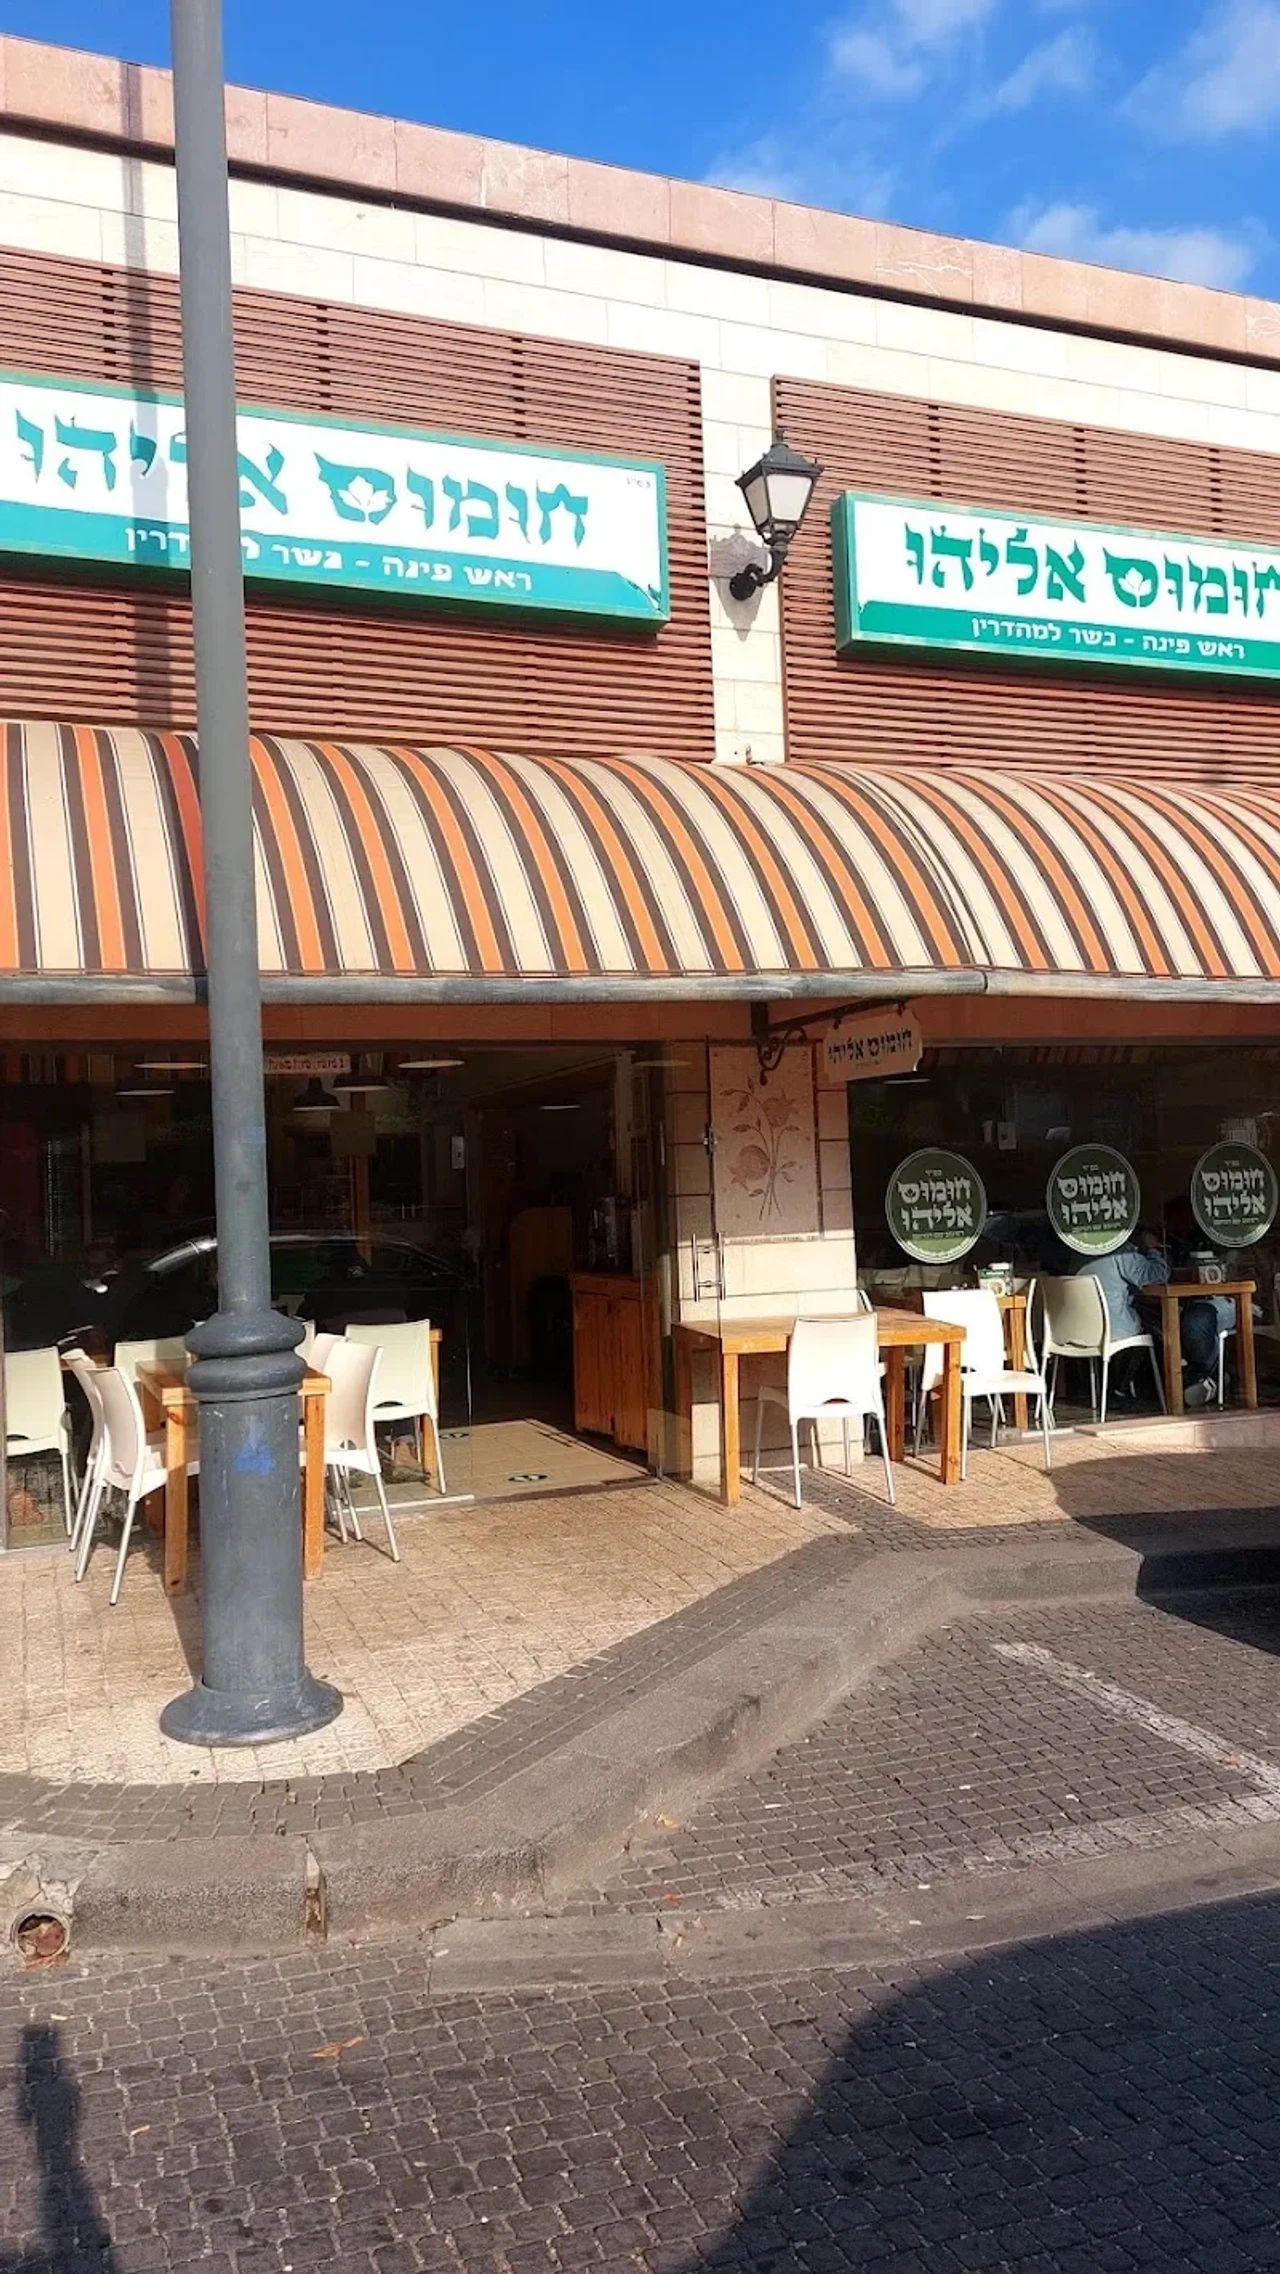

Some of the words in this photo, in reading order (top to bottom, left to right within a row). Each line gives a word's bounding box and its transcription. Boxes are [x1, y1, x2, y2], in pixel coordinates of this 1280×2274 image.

[314, 451, 589, 548] חומוס
[124, 527, 261, 560] לדרין
[382, 556, 453, 582] פינה
[904, 522, 1086, 603] אליהו
[463, 567, 533, 591] ראש
[971, 617, 1062, 641] למהדרין
[1068, 627, 1117, 646] כשר
[1142, 634, 1191, 654] פינה
[1196, 640, 1246, 659] ראש
[828, 1037, 865, 1065] אליהו
[867, 1028, 912, 1058] חומוס
[896, 1176, 971, 1205] חומוס
[1056, 1171, 1126, 1200] חומוס
[1201, 1167, 1265, 1192] חומוס
[901, 1201, 973, 1231] אליהו
[1061, 1194, 1128, 1225] אליהו
[1204, 1190, 1266, 1217] אליהו
